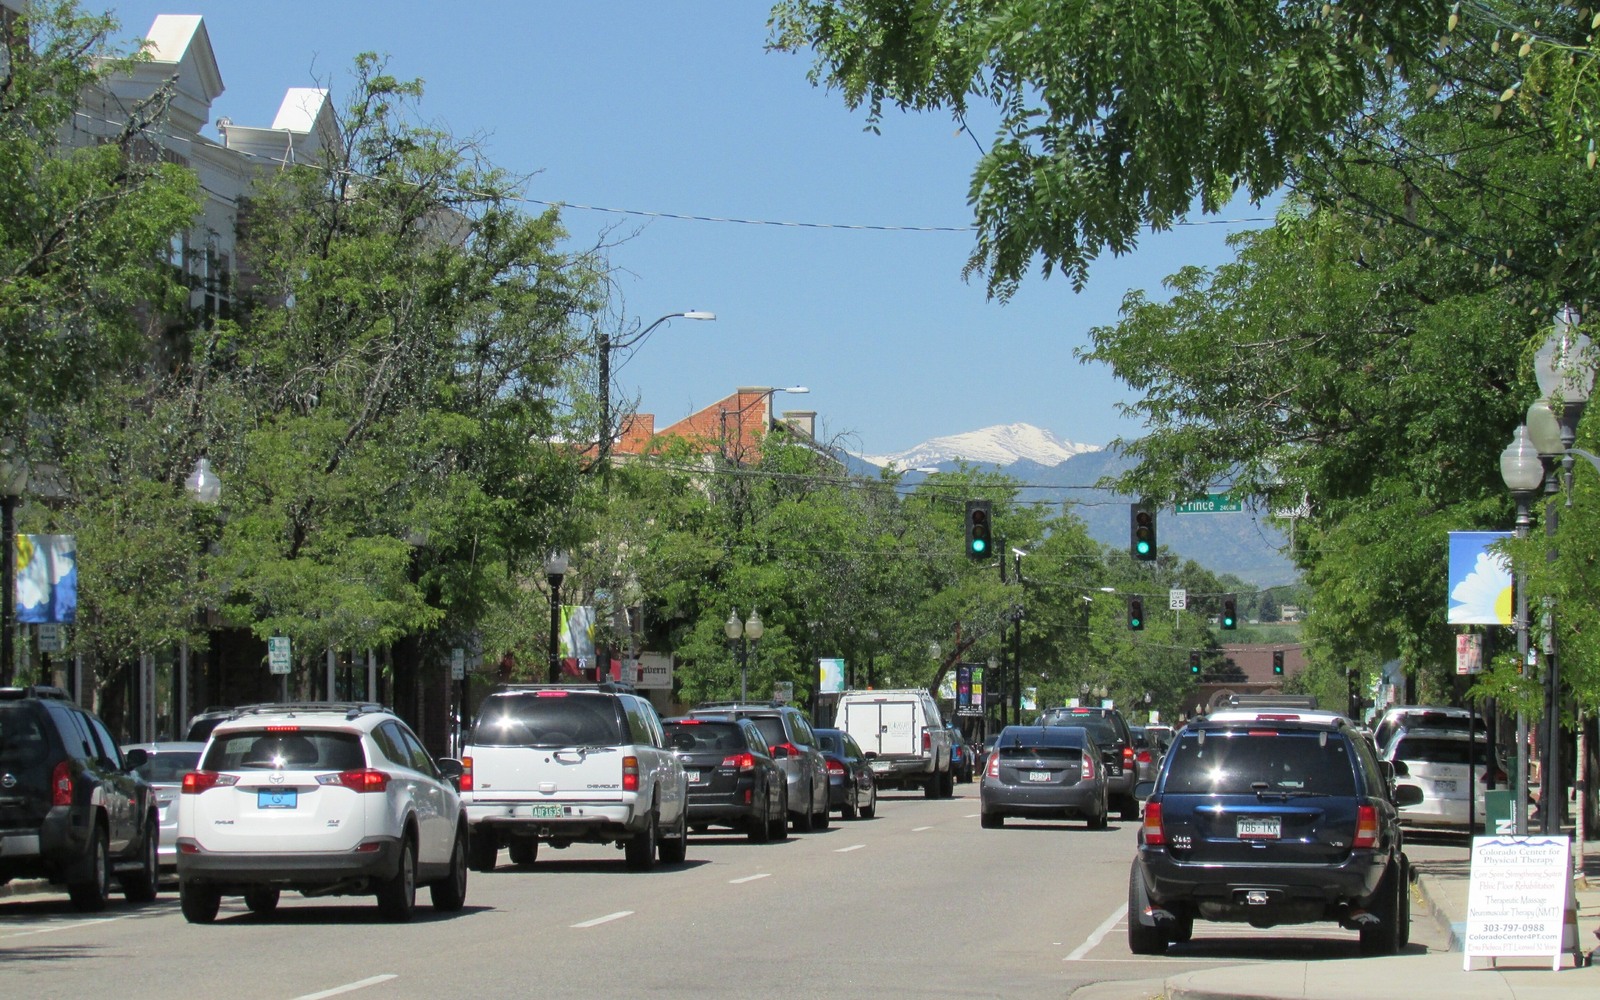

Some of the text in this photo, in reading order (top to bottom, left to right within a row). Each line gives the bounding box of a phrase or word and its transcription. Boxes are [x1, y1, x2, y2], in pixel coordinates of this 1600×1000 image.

[1171, 599, 1185, 608] 25
[643, 665, 667, 675] avern
[1479, 848, 1517, 856] Colorado
[1519, 848, 1547, 856] Center
[1483, 856, 1555, 866] Physical Therapy
[1497, 881, 1514, 890] Floor
[1515, 881, 1555, 891] Rehabilitation
[1485, 895, 1547, 906] Therapeutic Massage
[1469, 906, 1560, 919] Neuromuscular Therapy (NMT)
[1483, 924, 1545, 932] 303-797-0988
